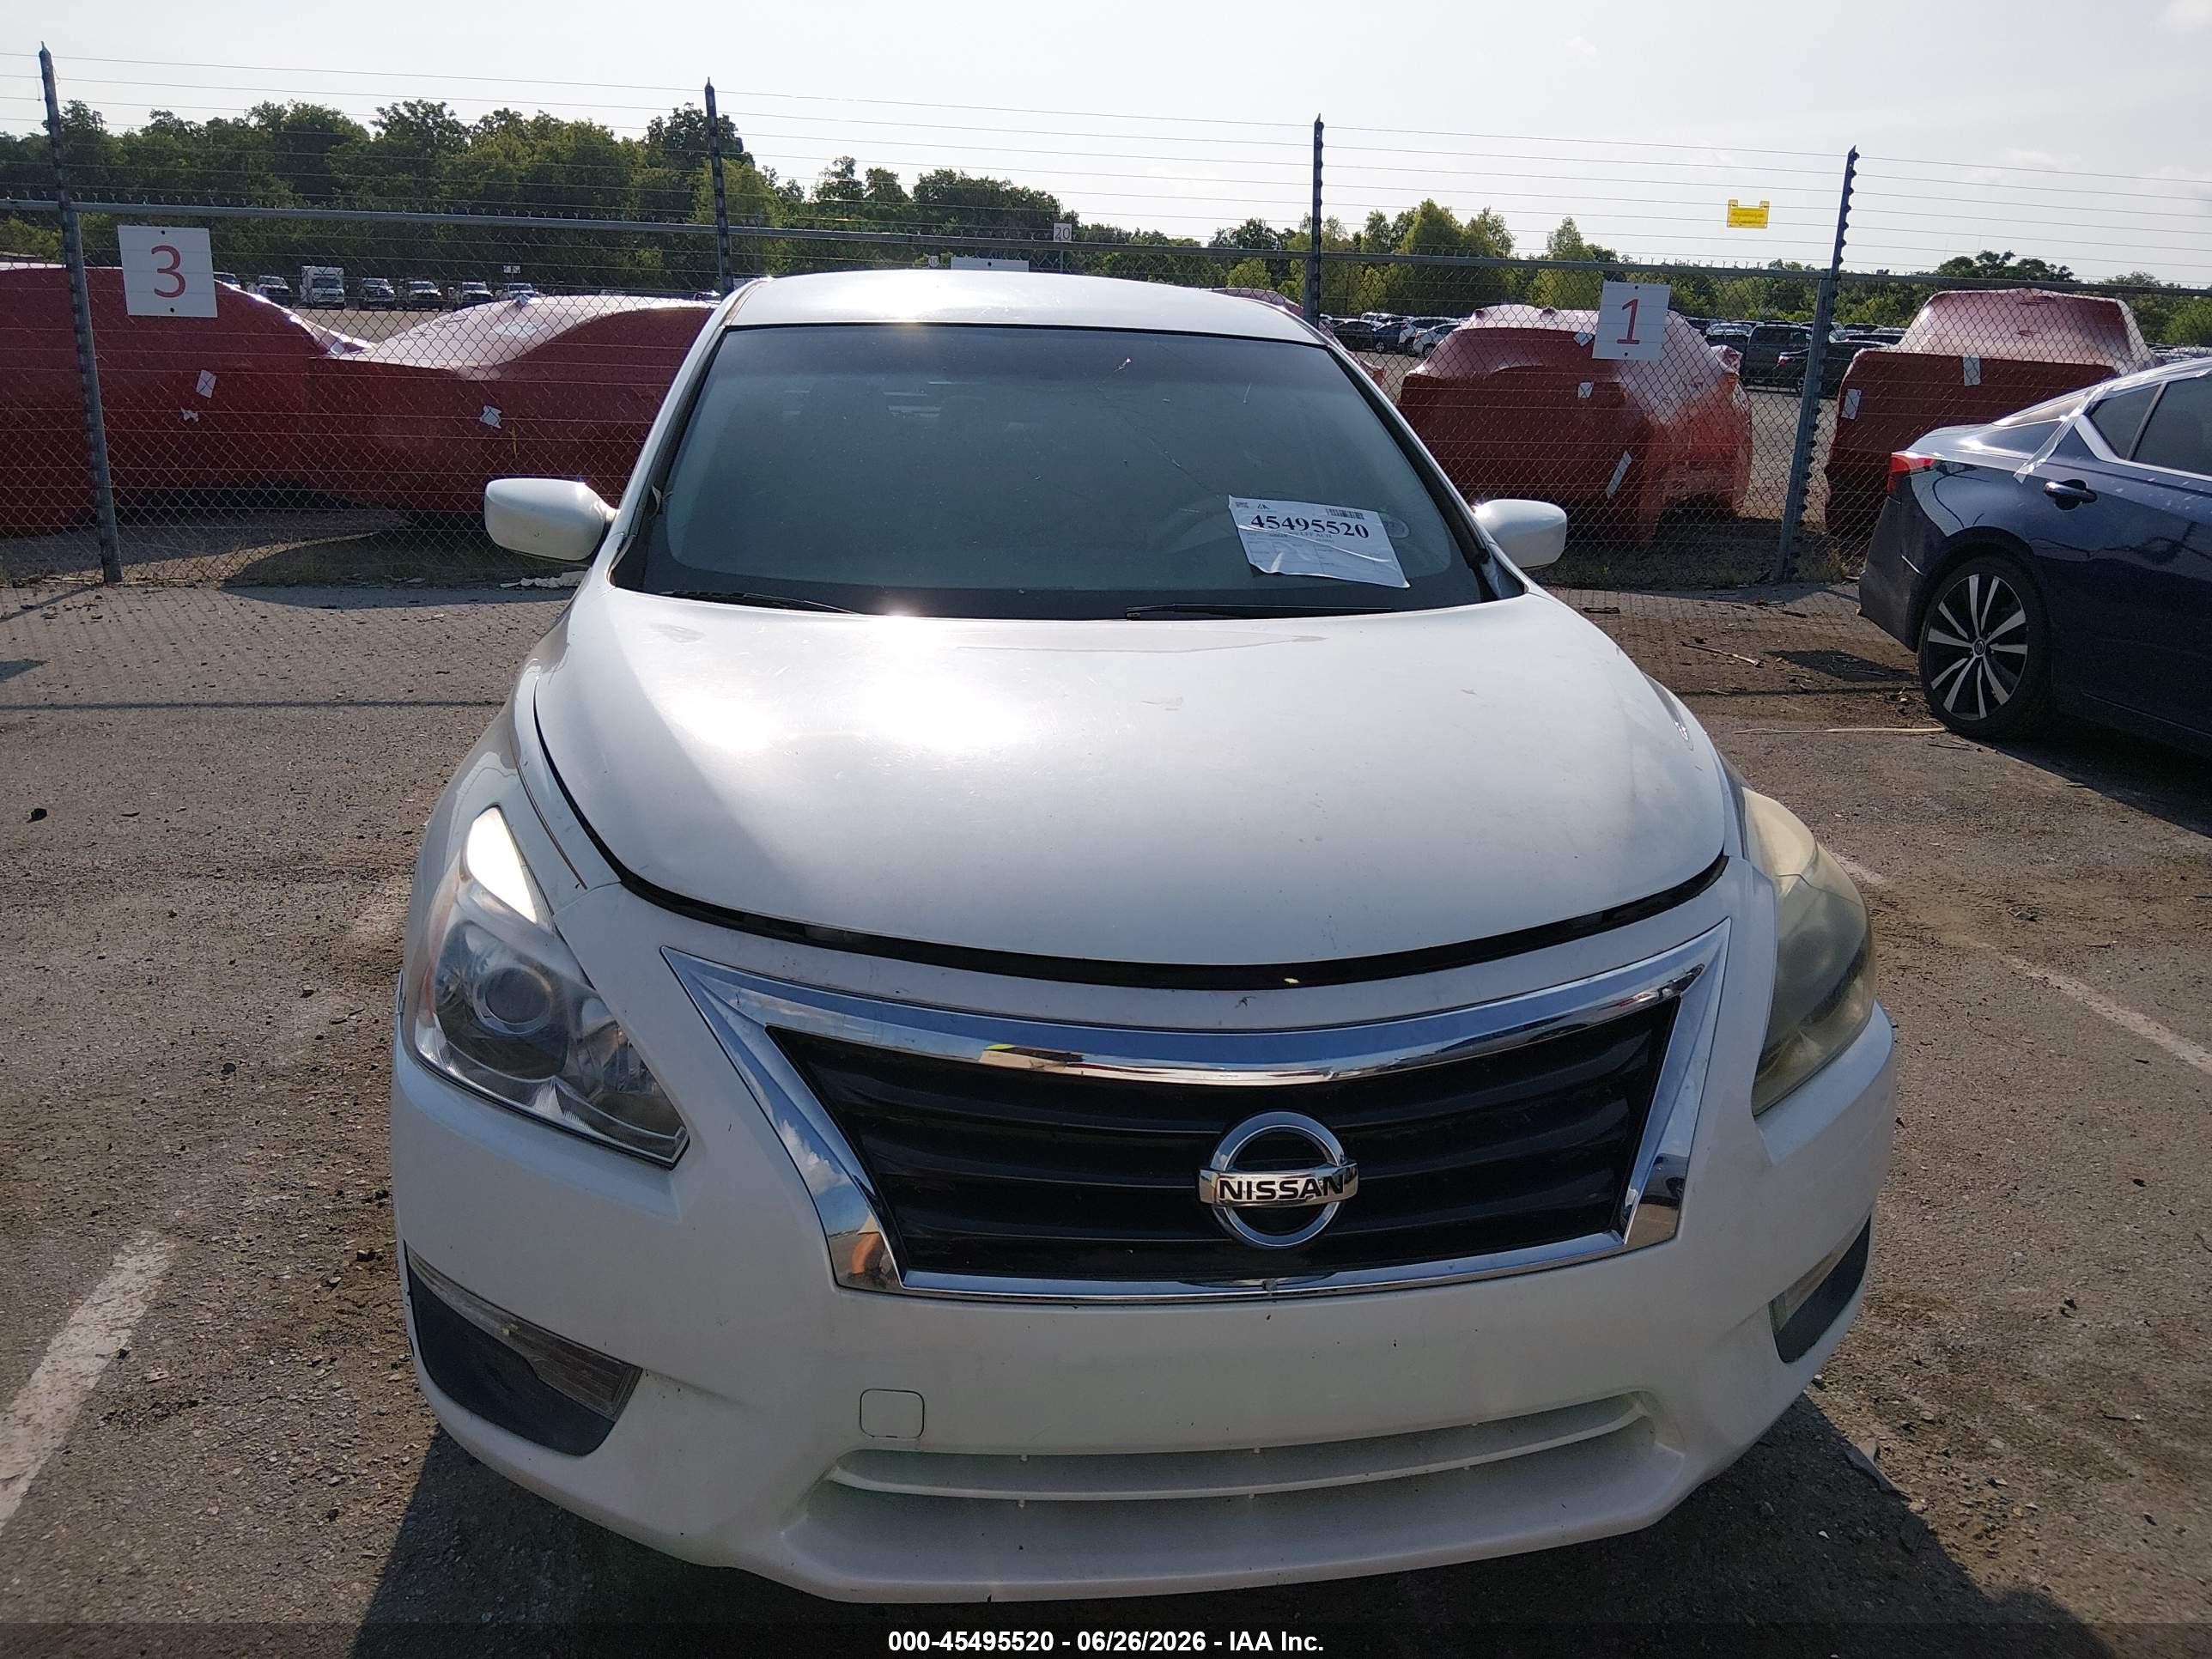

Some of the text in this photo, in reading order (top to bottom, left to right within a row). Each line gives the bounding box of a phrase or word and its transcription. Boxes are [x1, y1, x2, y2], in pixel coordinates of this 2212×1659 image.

[1055, 227, 1071, 240] 20
[151, 245, 186, 299] 3
[1616, 298, 1640, 345] 1
[1250, 514, 1370, 538] 45495520
[1218, 1174, 1345, 1201] NISSAN
